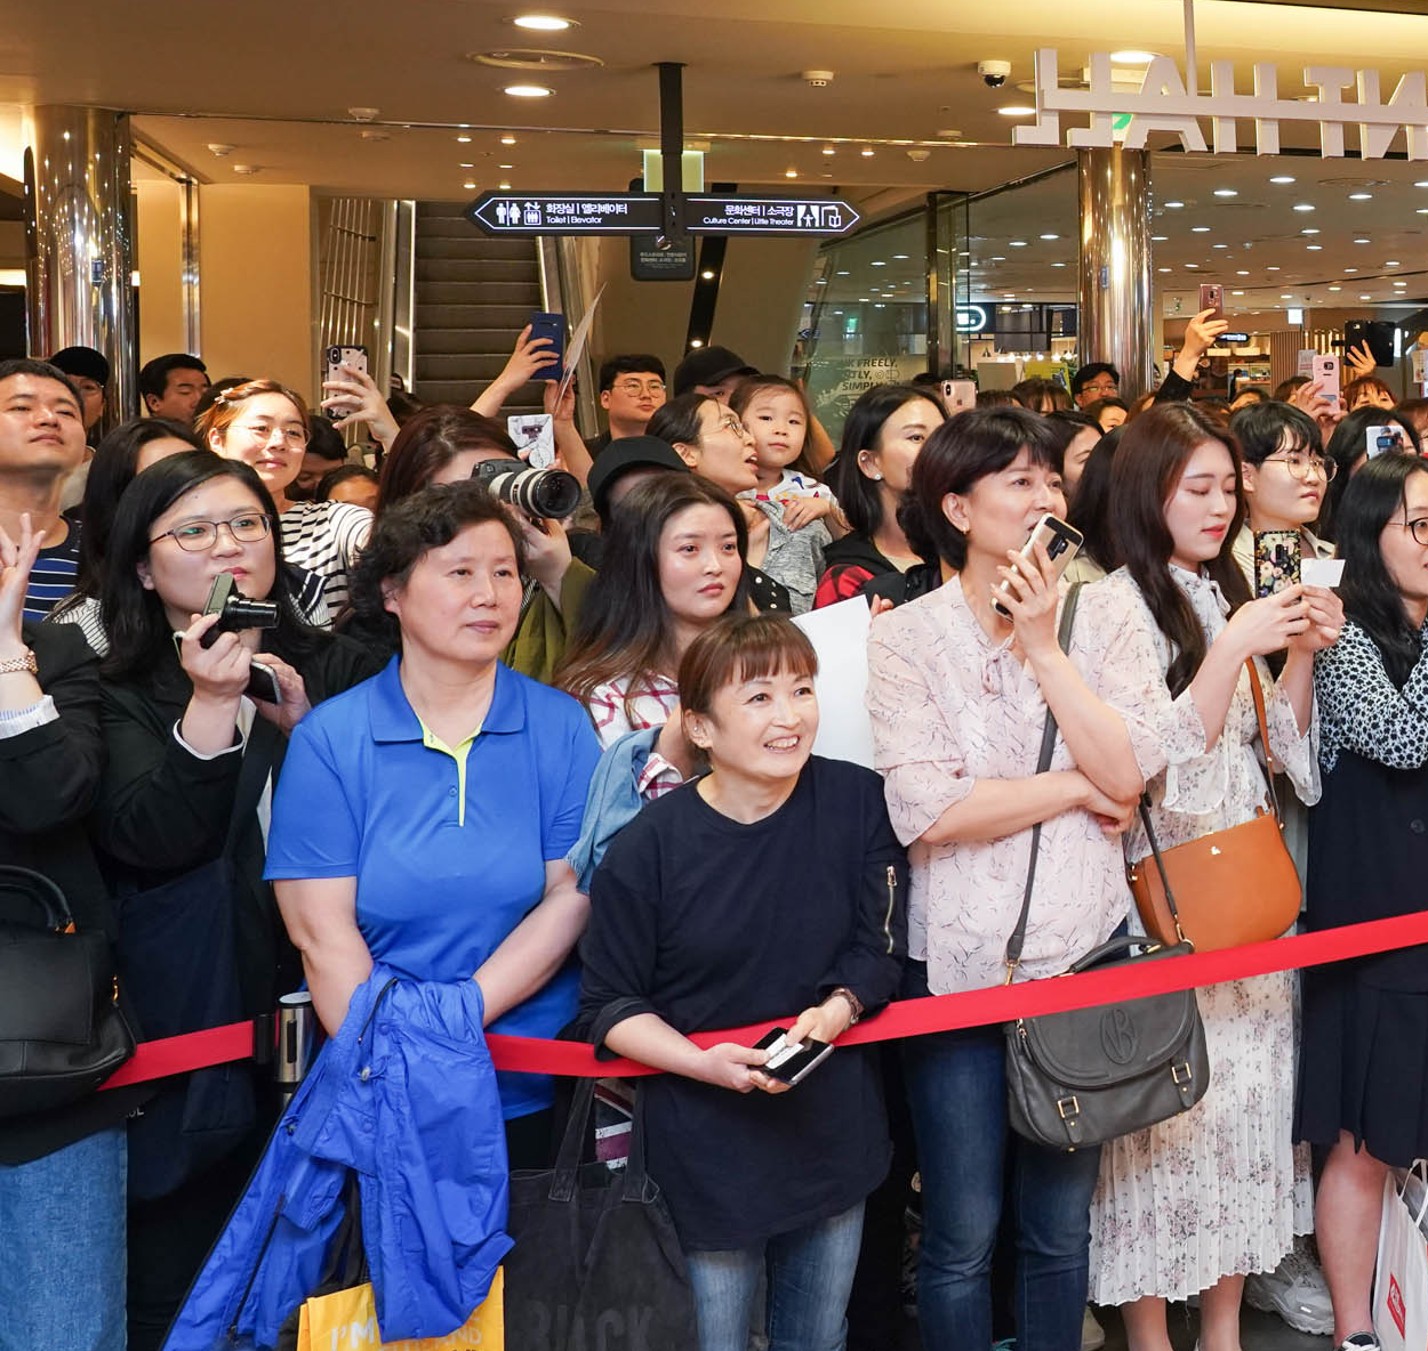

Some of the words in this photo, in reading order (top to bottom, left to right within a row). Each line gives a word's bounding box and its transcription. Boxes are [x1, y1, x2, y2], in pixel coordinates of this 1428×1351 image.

[546, 203, 575, 214] 화장실
[725, 205, 760, 216] 문화센터
[767, 206, 794, 217] 소극장
[546, 216, 566, 224] Toilet
[571, 216, 602, 224] Elevator
[728, 217, 751, 225] Center
[769, 218, 794, 226] Theater
